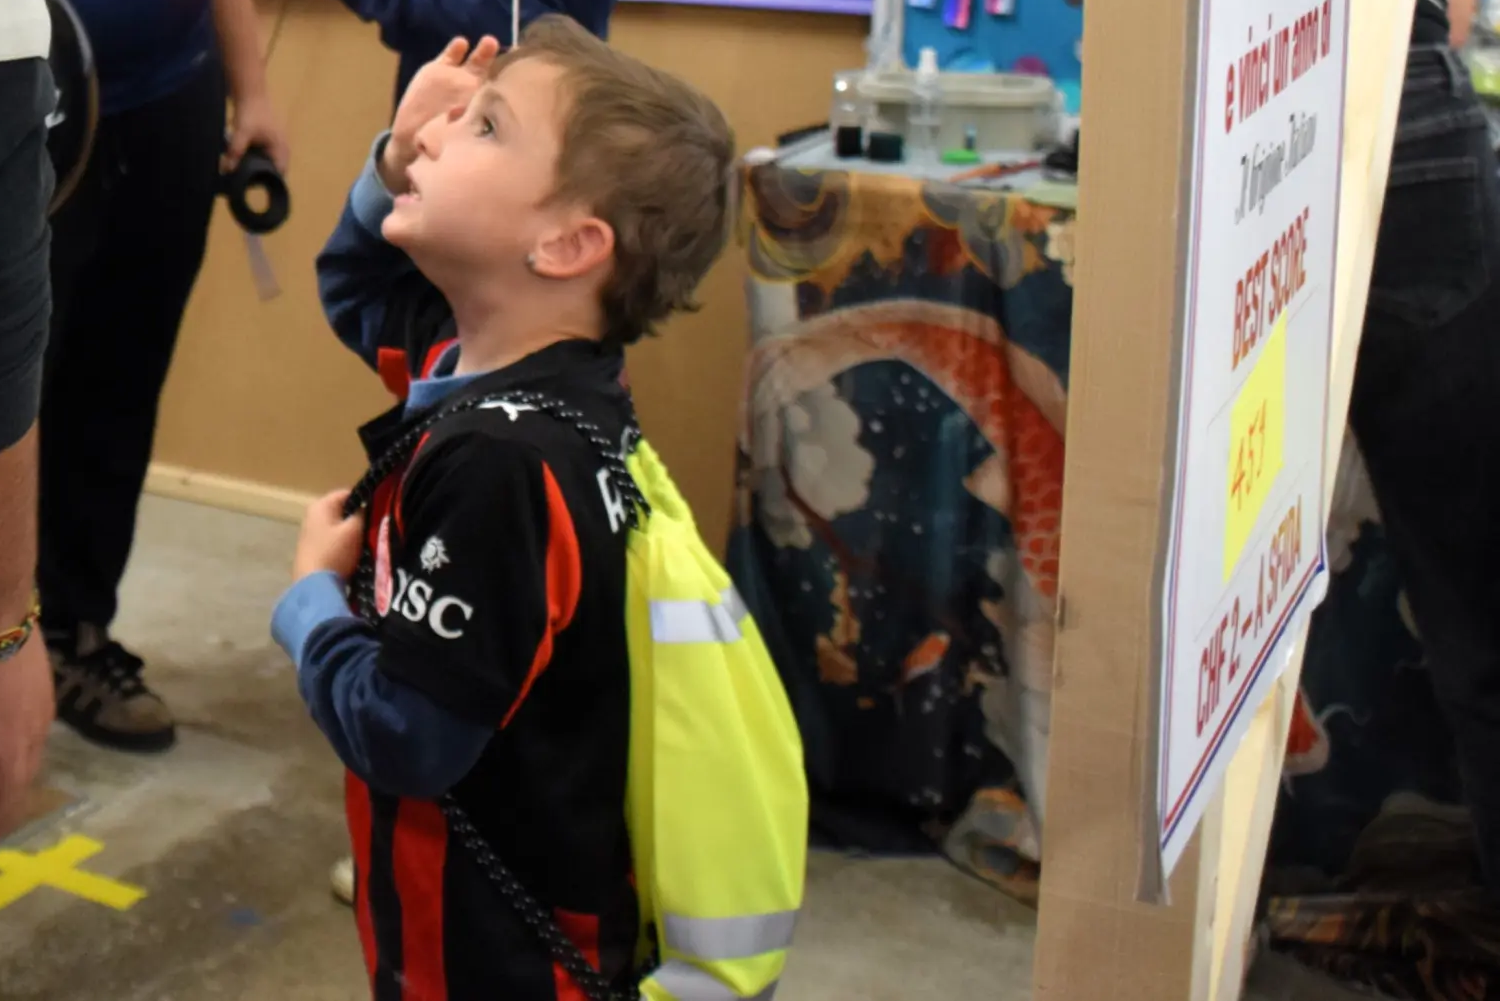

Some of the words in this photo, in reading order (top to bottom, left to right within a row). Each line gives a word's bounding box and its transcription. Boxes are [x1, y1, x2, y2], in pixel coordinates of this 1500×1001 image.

[1225, 63, 1234, 133] e
[1238, 13, 1271, 122] vinci
[1273, 26, 1289, 96] un
[1231, 249, 1269, 371] BEST
[1268, 205, 1309, 325] SCORE
[1196, 612, 1228, 737] CHF
[1254, 554, 1264, 638] A
